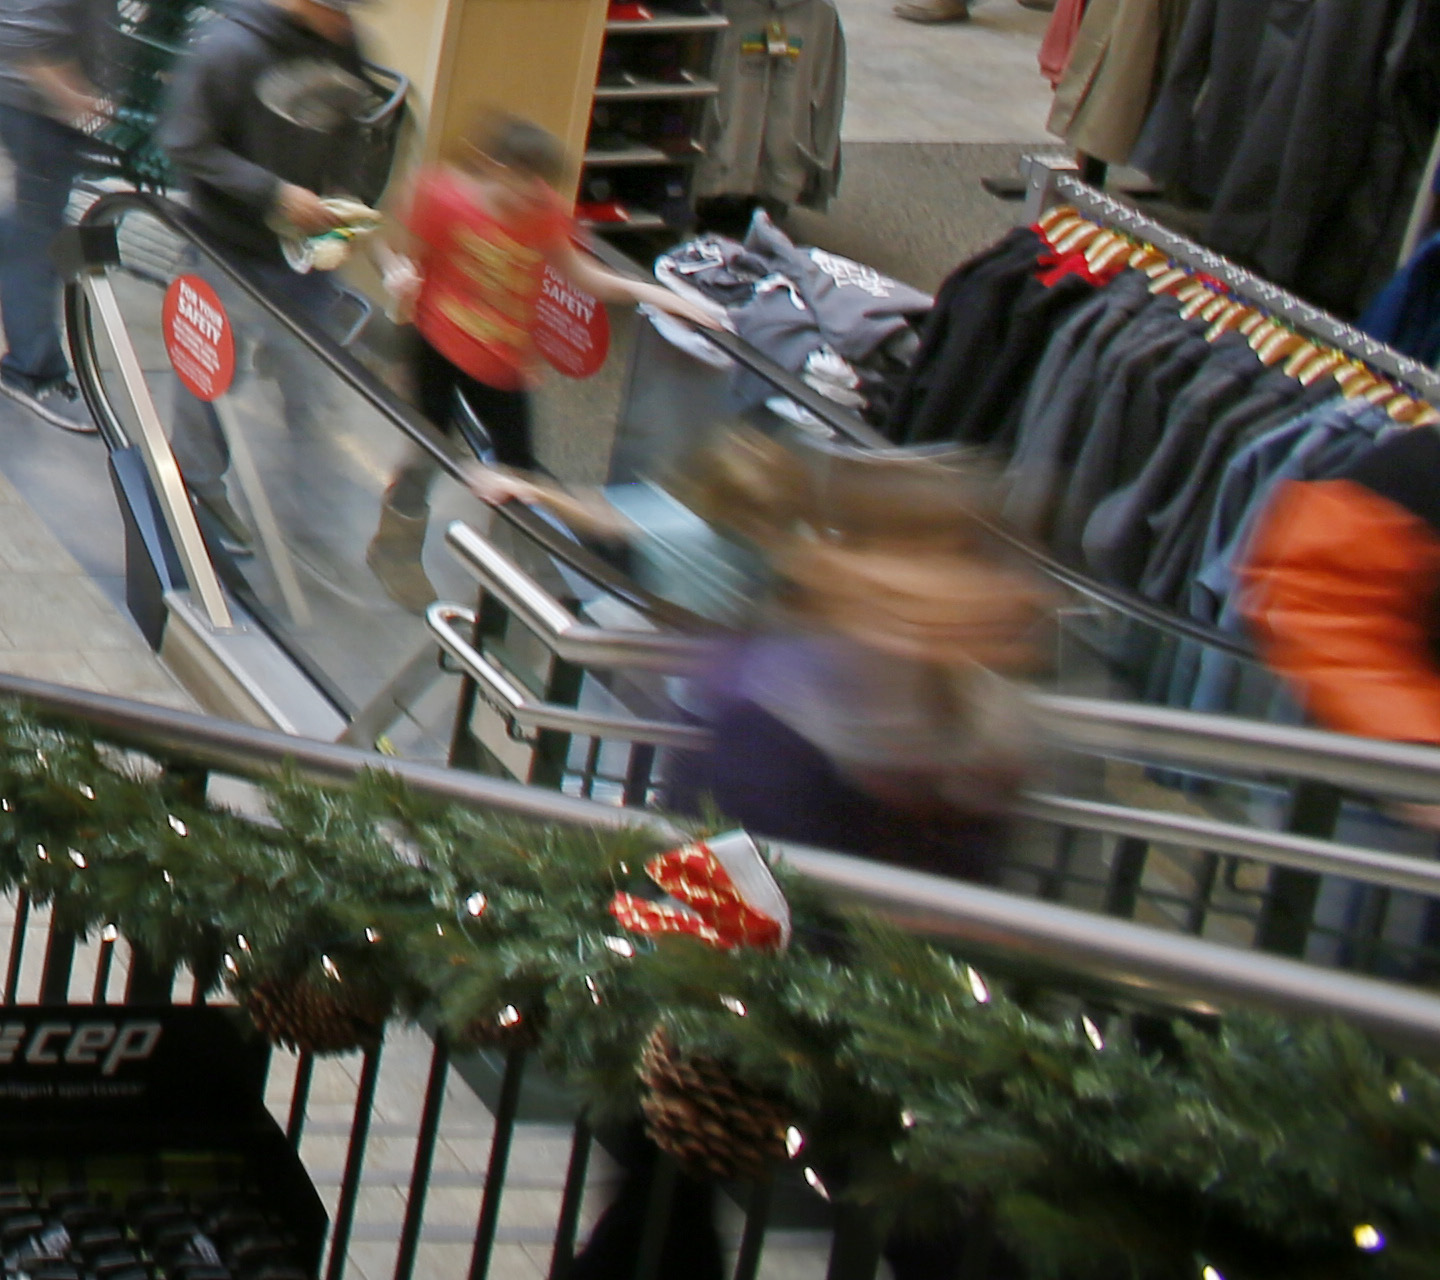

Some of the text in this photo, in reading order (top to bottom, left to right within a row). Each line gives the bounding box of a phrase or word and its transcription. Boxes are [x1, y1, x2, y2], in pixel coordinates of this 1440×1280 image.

[180, 279, 223, 329] FOR YOUR
[541, 278, 595, 325] SAFETY
[544, 264, 597, 309] FOR YOUR
[178, 295, 222, 346] SAFETY
[26, 1022, 163, 1076] cep
